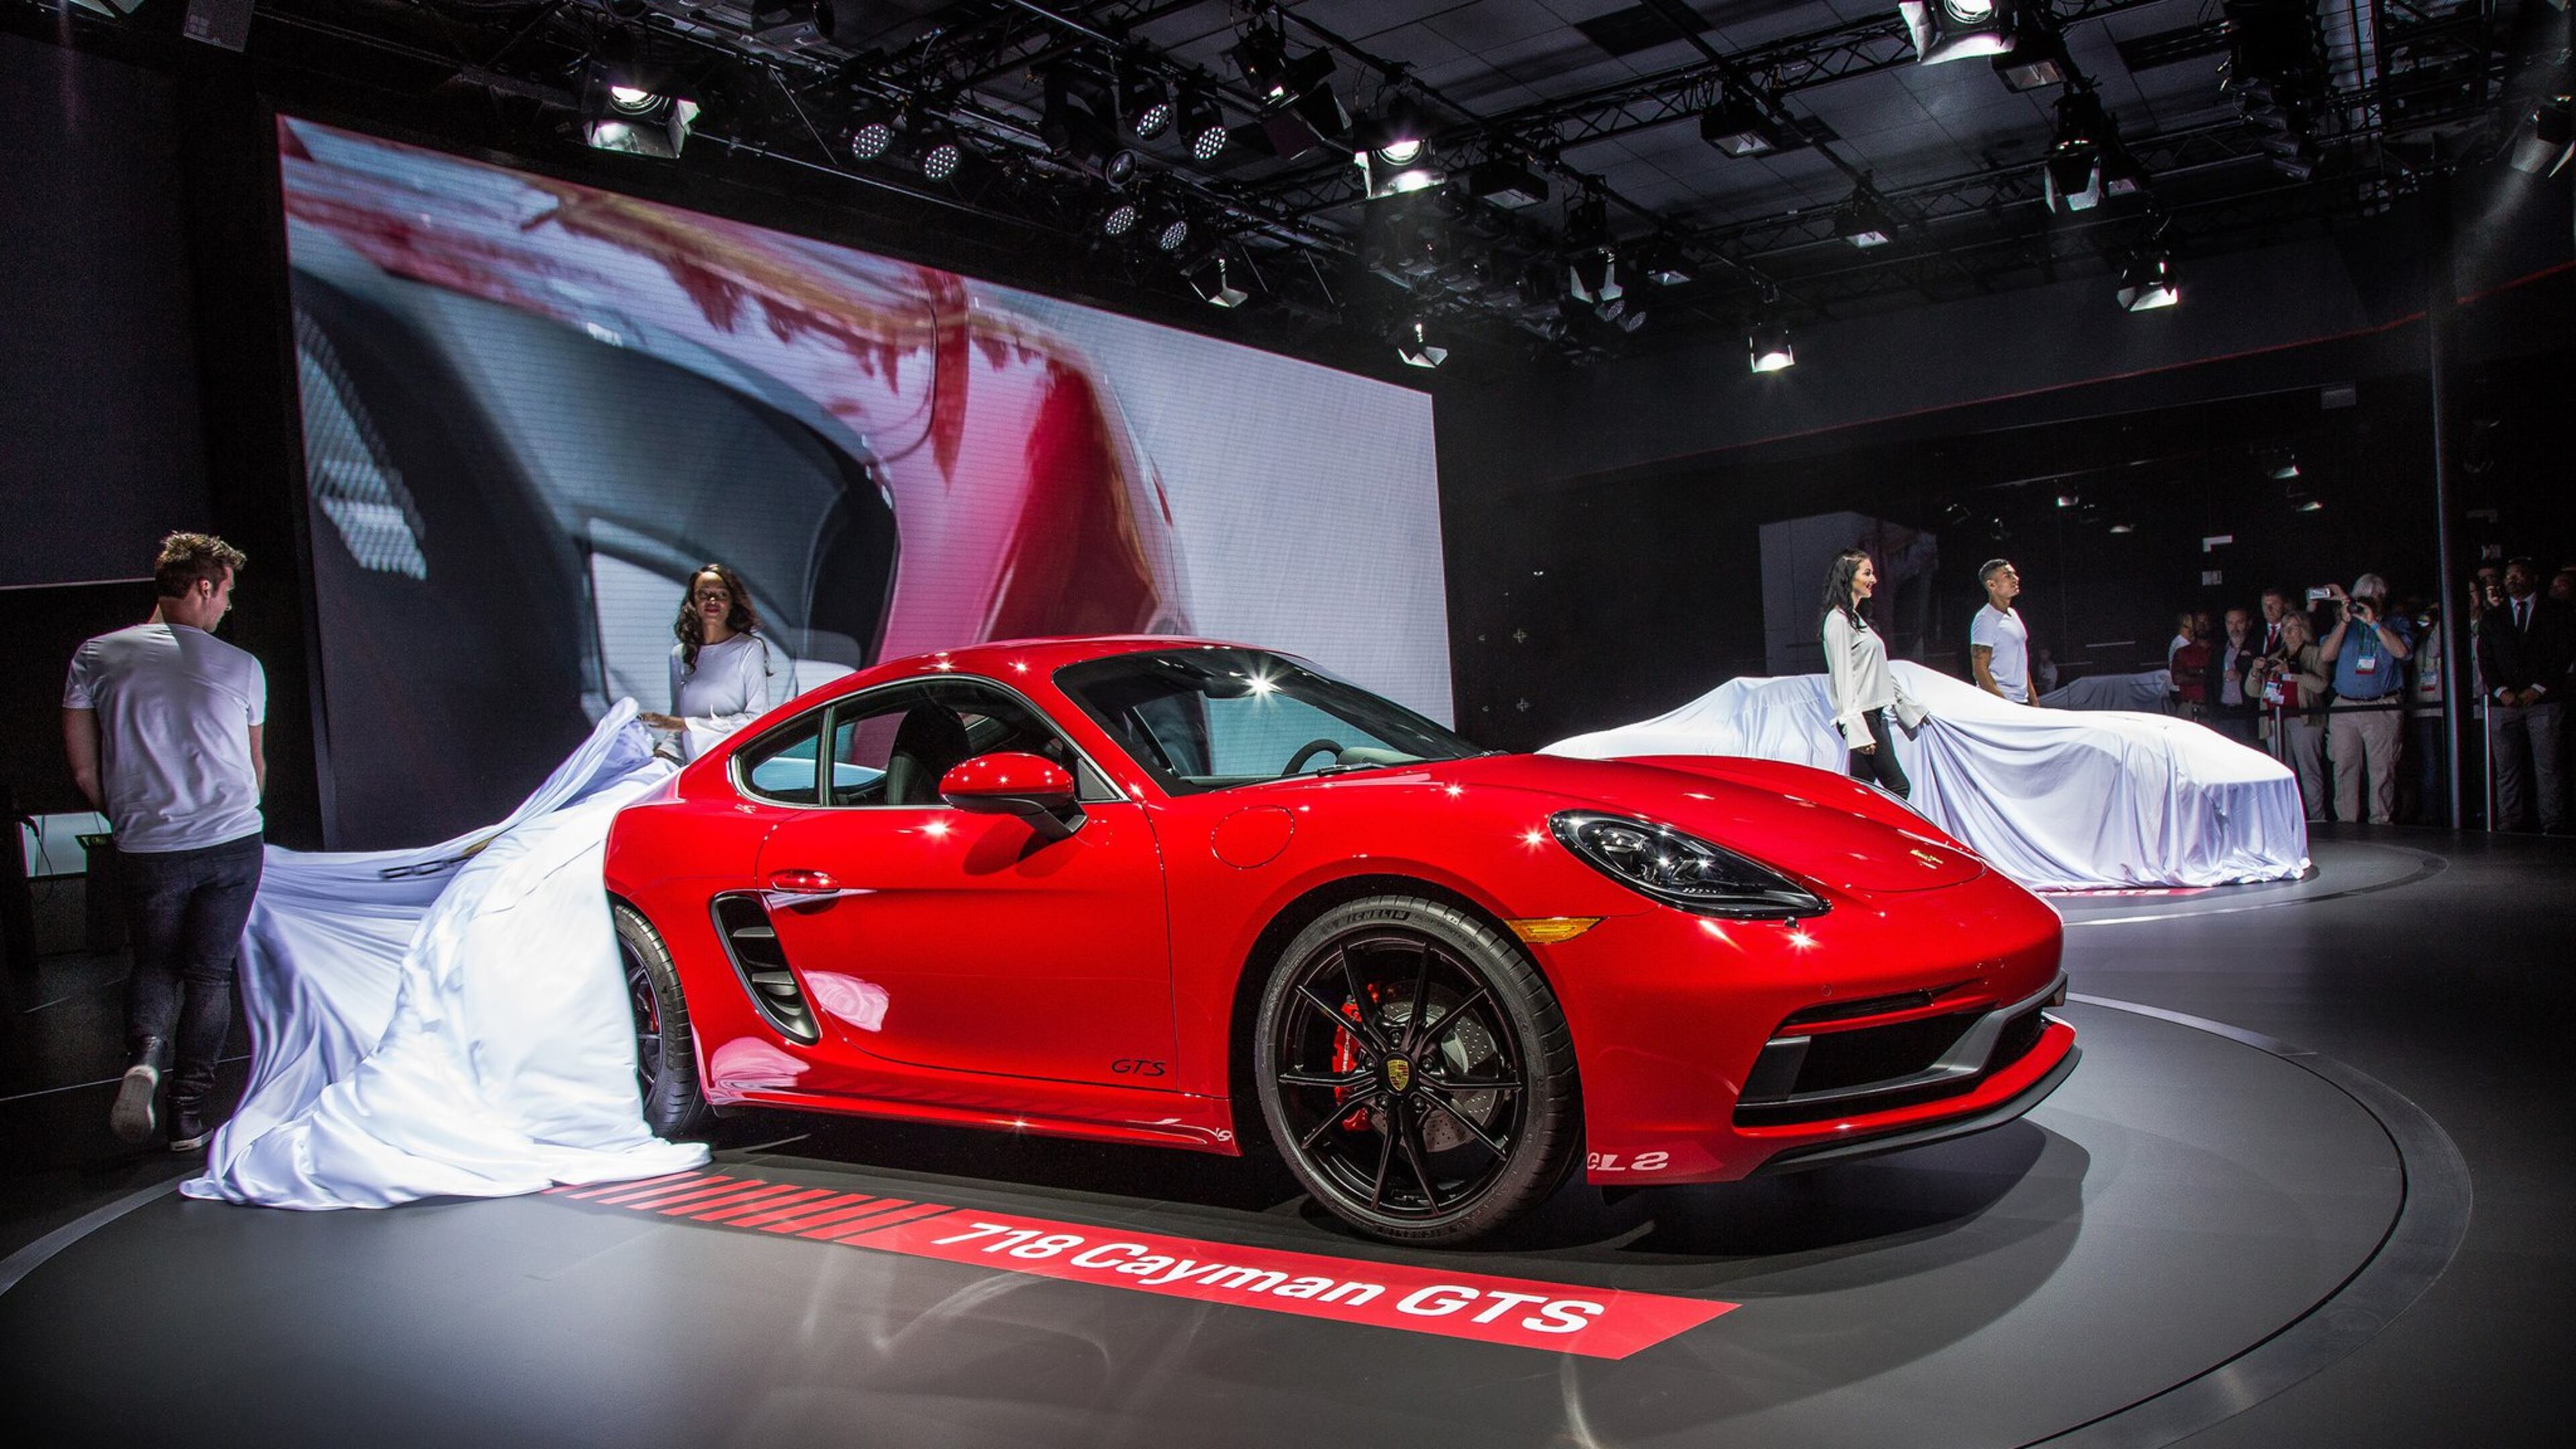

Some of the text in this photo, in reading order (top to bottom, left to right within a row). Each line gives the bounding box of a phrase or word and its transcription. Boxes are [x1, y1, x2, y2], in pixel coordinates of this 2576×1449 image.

[1110, 1058, 1167, 1077] GTS
[930, 1222, 1605, 1333] 718 Cayman GTS
